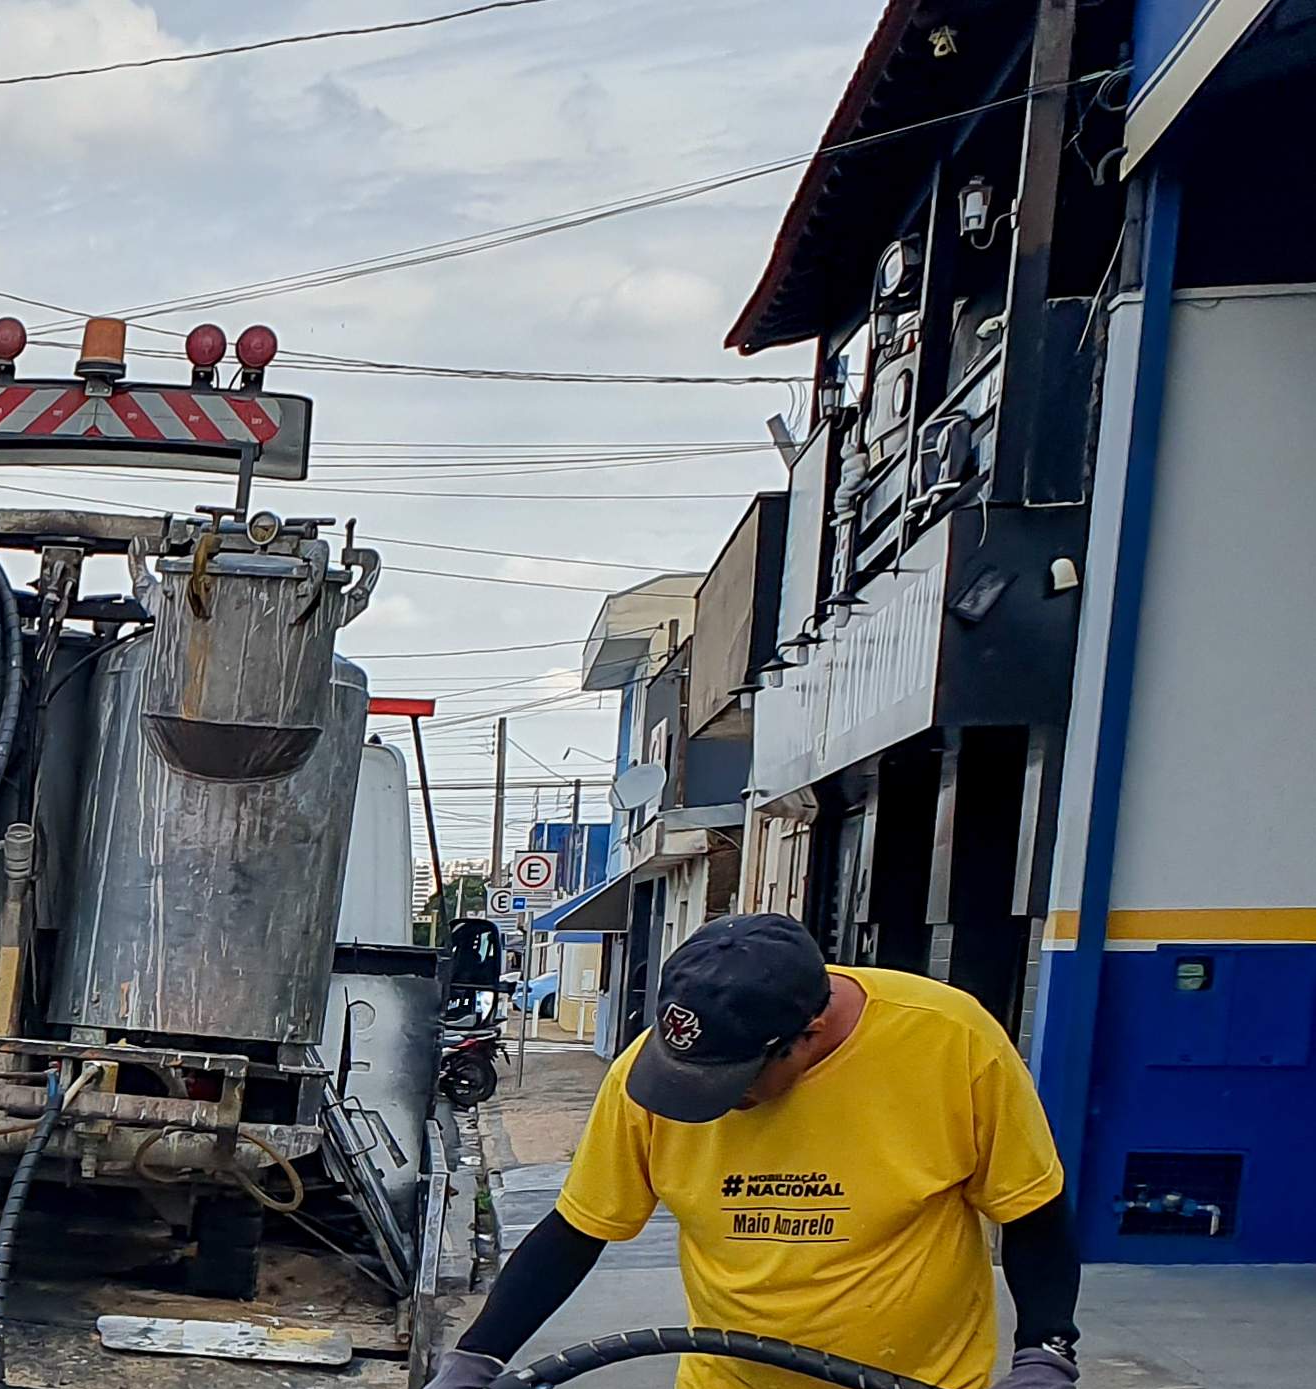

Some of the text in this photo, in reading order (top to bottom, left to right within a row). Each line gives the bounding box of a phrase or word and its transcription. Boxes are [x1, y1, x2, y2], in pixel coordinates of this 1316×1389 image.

[527, 863, 541, 880] E
[497, 895, 508, 909] E
[746, 1183, 845, 1197] NACIONAL
[733, 1213, 834, 1236] Maio Amarelo
